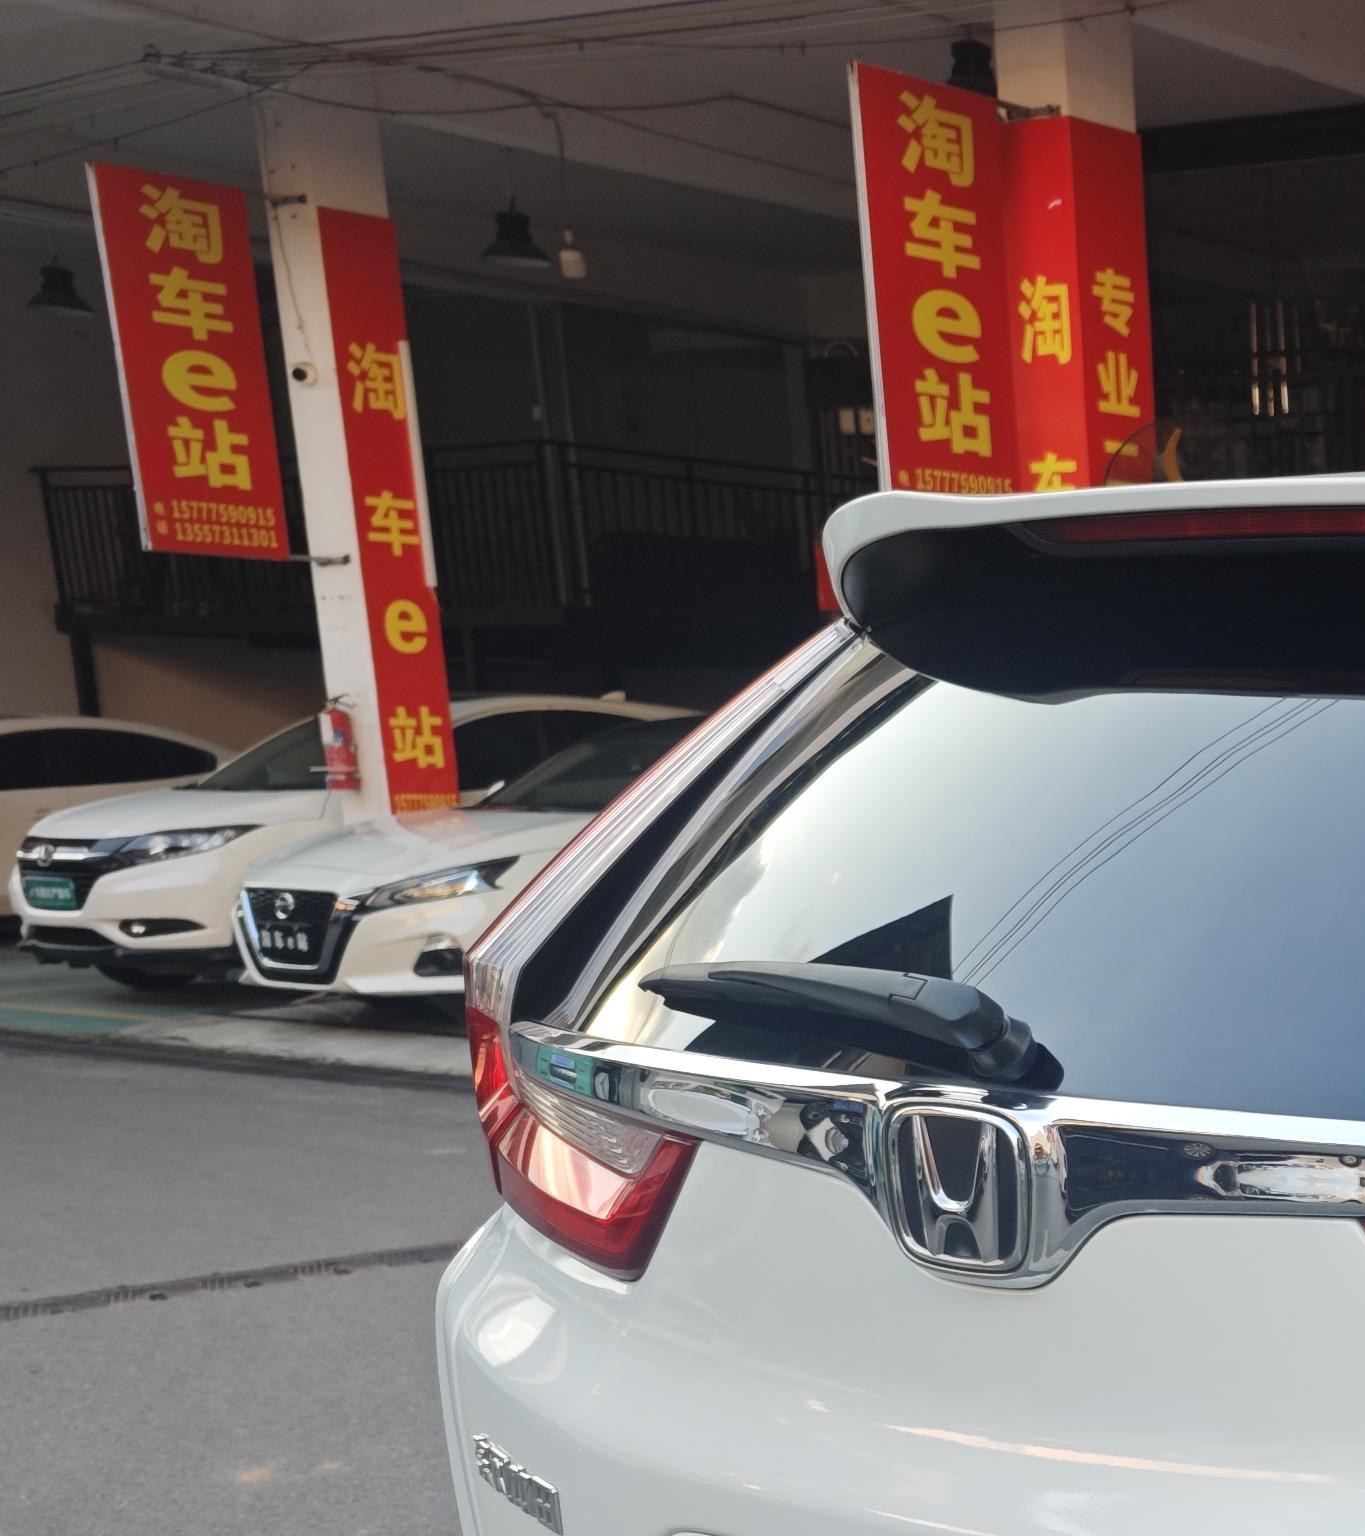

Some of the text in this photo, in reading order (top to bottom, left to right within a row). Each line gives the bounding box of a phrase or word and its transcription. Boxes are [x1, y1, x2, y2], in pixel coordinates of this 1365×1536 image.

[138, 183, 253, 491] 淘车e站
[897, 91, 992, 457] 淘车e站
[347, 341, 447, 770] 淘车e站
